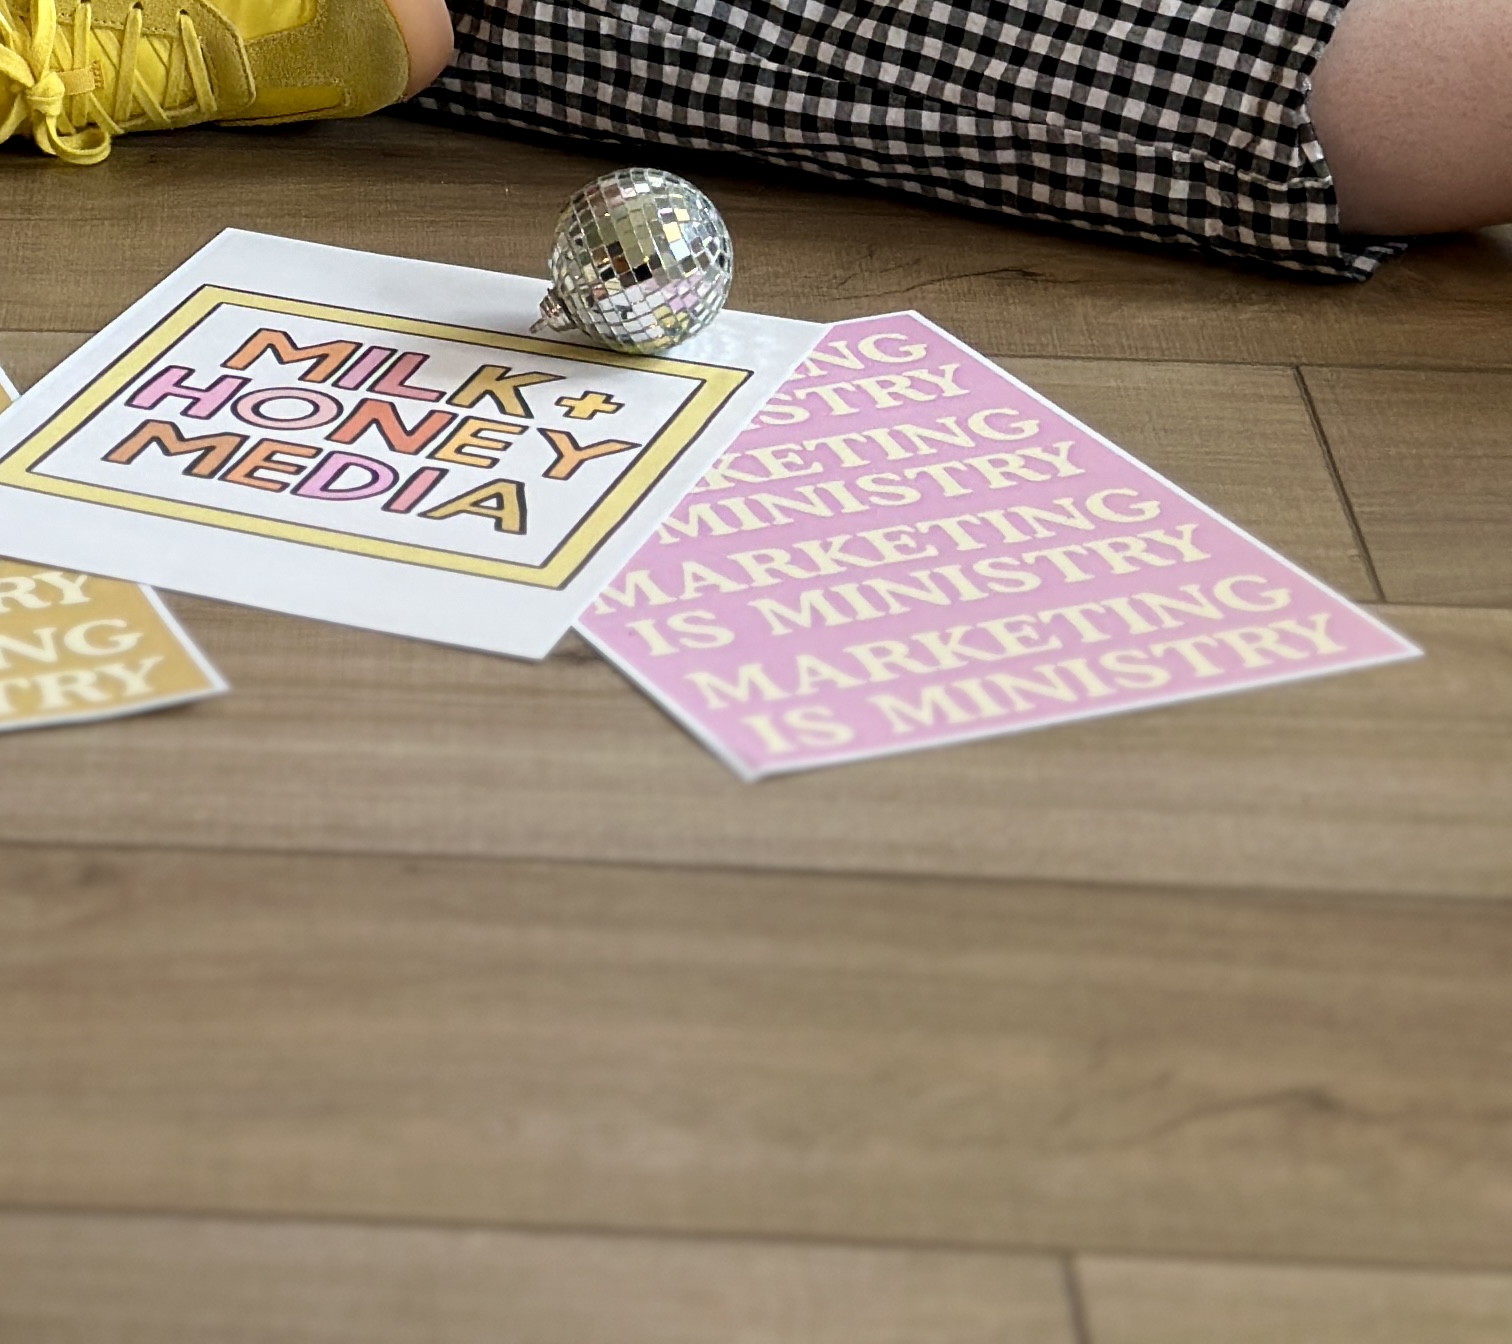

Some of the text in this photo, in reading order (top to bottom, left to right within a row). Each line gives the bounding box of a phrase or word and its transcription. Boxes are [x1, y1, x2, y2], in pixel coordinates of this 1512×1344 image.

[124, 364, 643, 481] HONEY
[220, 327, 626, 420] MILK+
[101, 418, 528, 535] MEDIA
[658, 440, 1086, 545] MINISTRY
[593, 488, 1161, 615] MARKETING
[626, 523, 1212, 657] IS MINISTRY
[684, 574, 1292, 710] MARKETING
[741, 612, 1348, 754] IS MINISTRY
